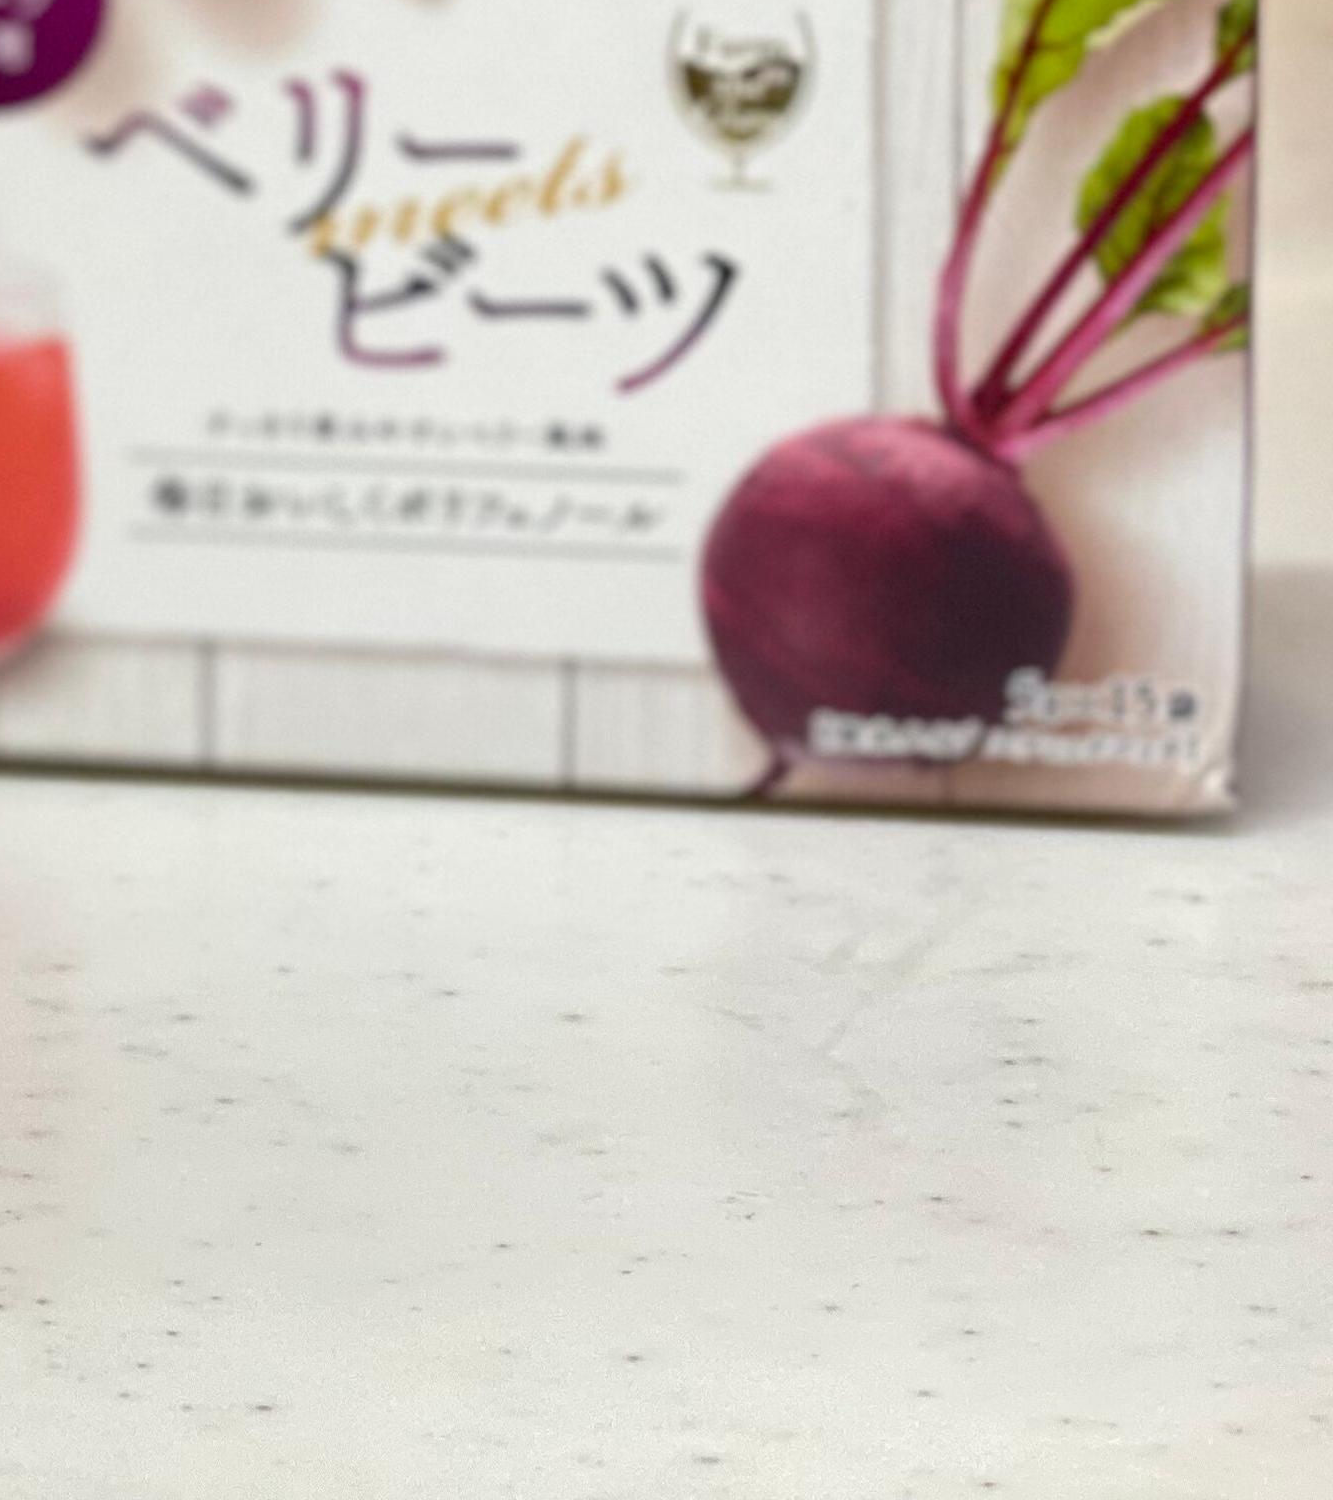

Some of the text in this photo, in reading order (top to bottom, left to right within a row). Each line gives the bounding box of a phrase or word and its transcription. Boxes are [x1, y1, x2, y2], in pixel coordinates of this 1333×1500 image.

[86, 68, 523, 235] ベリー
[307, 136, 629, 259] meets
[323, 235, 741, 395] ビーツ
